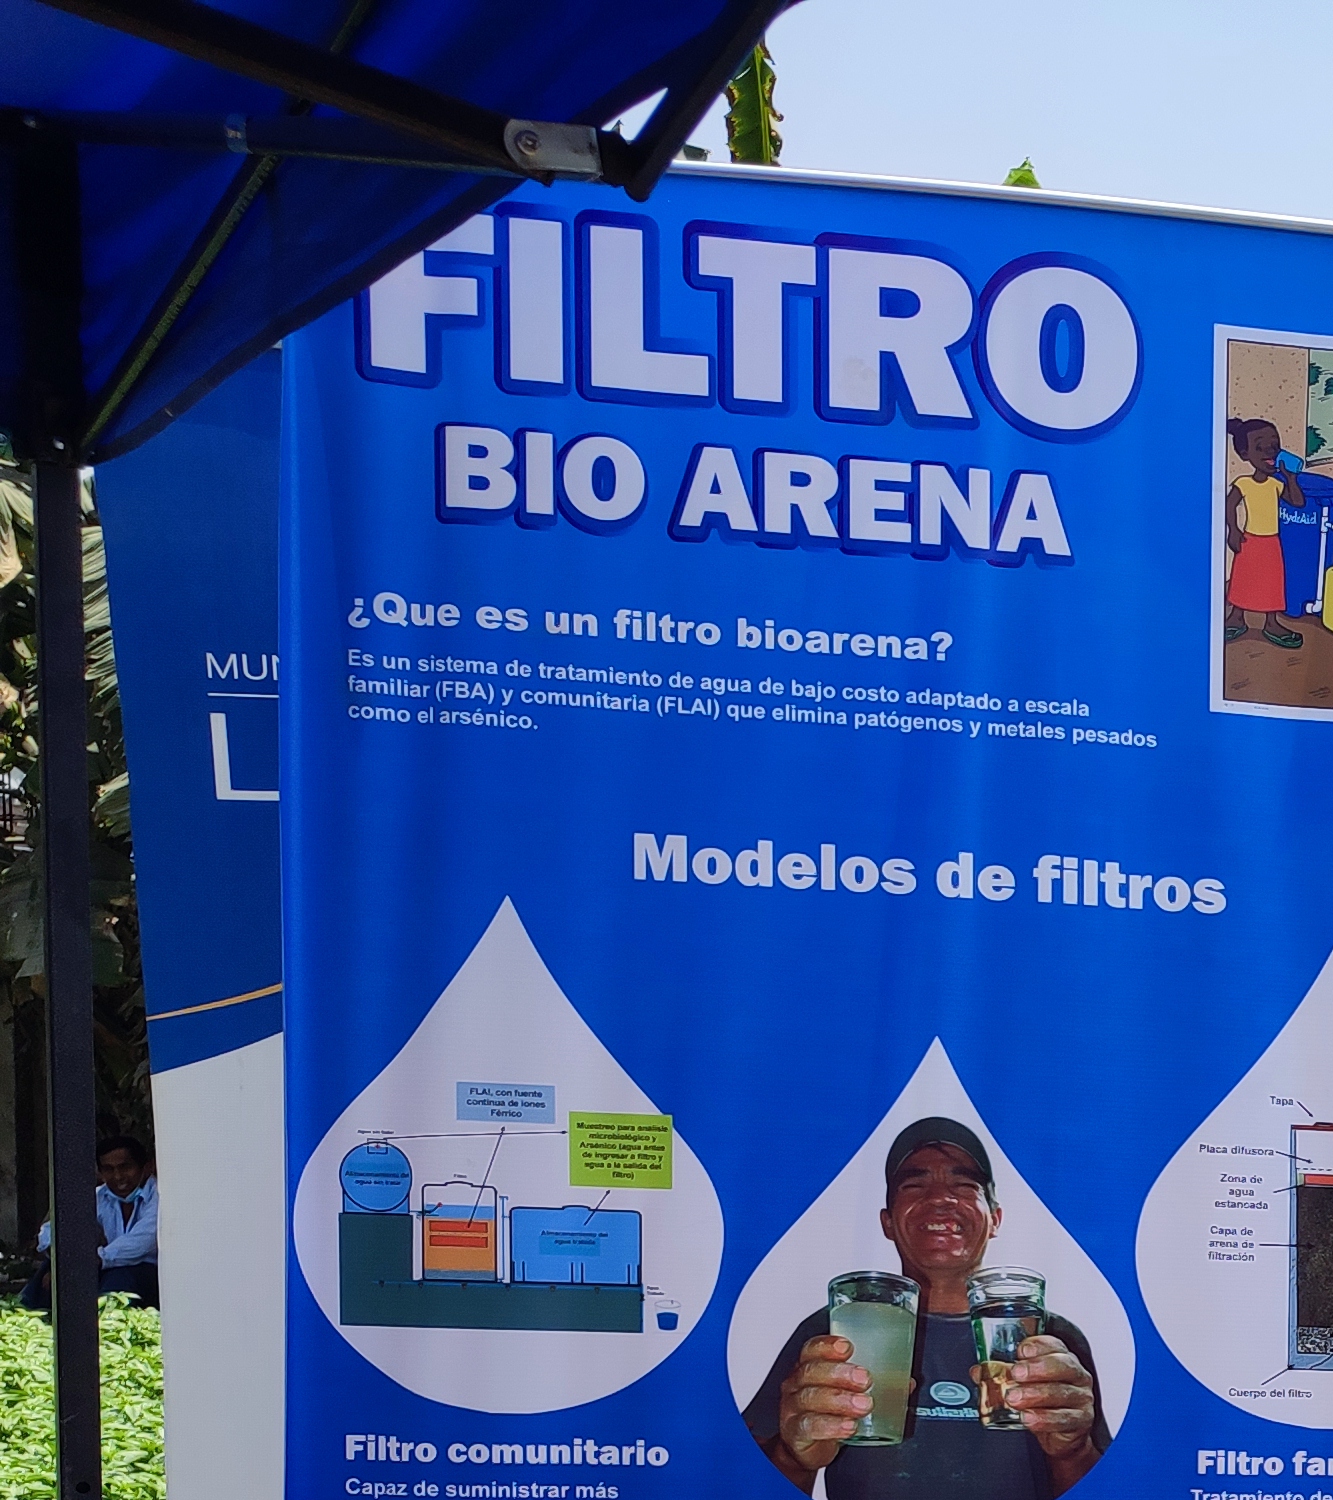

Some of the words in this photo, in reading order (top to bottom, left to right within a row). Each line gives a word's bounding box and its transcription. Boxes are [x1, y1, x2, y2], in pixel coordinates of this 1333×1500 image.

[368, 212, 1140, 432] FILTRO
[435, 422, 644, 530] BIO
[667, 443, 1071, 560] ARENA
[348, 592, 460, 628] ¿Que
[476, 606, 528, 631] es
[545, 612, 598, 636] un
[613, 609, 721, 645] filtro
[737, 618, 953, 661] bioarena?
[634, 833, 916, 894] Modelos
[936, 852, 1015, 901] de
[1033, 855, 1226, 914] filtros
[1270, 1096, 1294, 1106] Tapa
[1199, 1144, 1227, 1153] Placa
[1231, 1146, 1274, 1156] difusora
[1229, 1388, 1266, 1399] Cuerpo
[1270, 1389, 1285, 1397] del
[1288, 1389, 1312, 1398] filtro
[346, 1434, 437, 1462] Filtro
[448, 1438, 669, 1466] comunitario
[1198, 1450, 1284, 1475] Filtro
